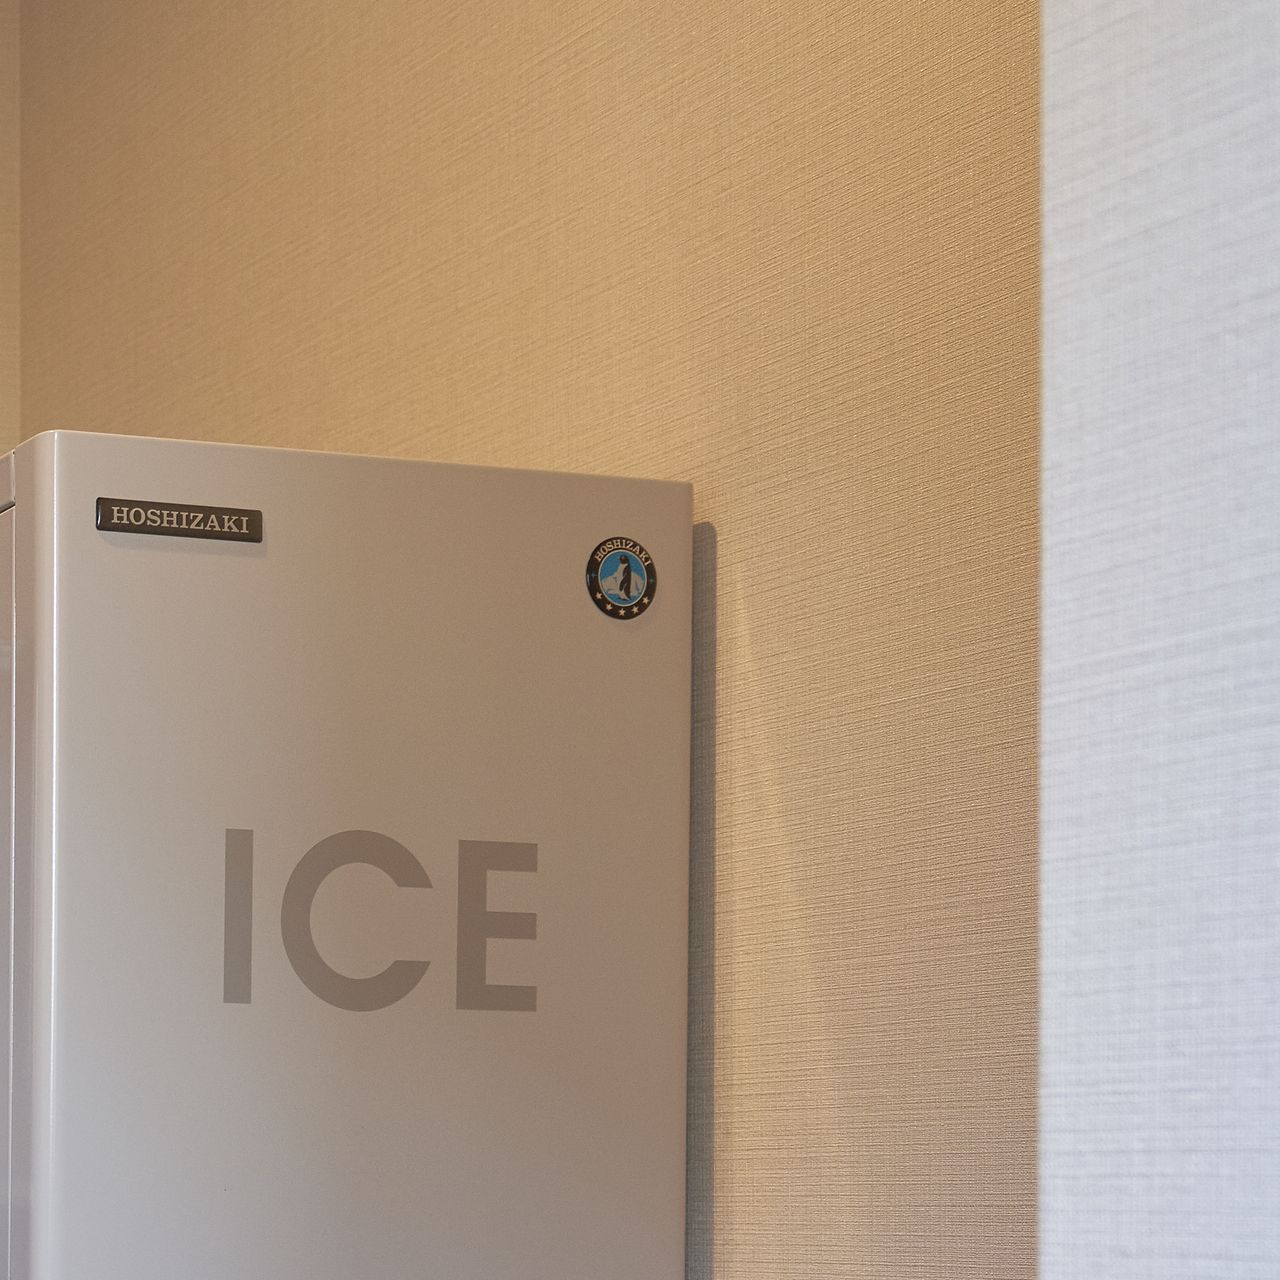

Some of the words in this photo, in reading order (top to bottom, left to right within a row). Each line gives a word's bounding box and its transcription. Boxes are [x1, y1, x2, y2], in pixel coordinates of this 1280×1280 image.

[110, 505, 251, 534] HOSHIZAKI
[594, 539, 653, 567] HOSHIZAKI
[222, 827, 540, 1012] ICE
